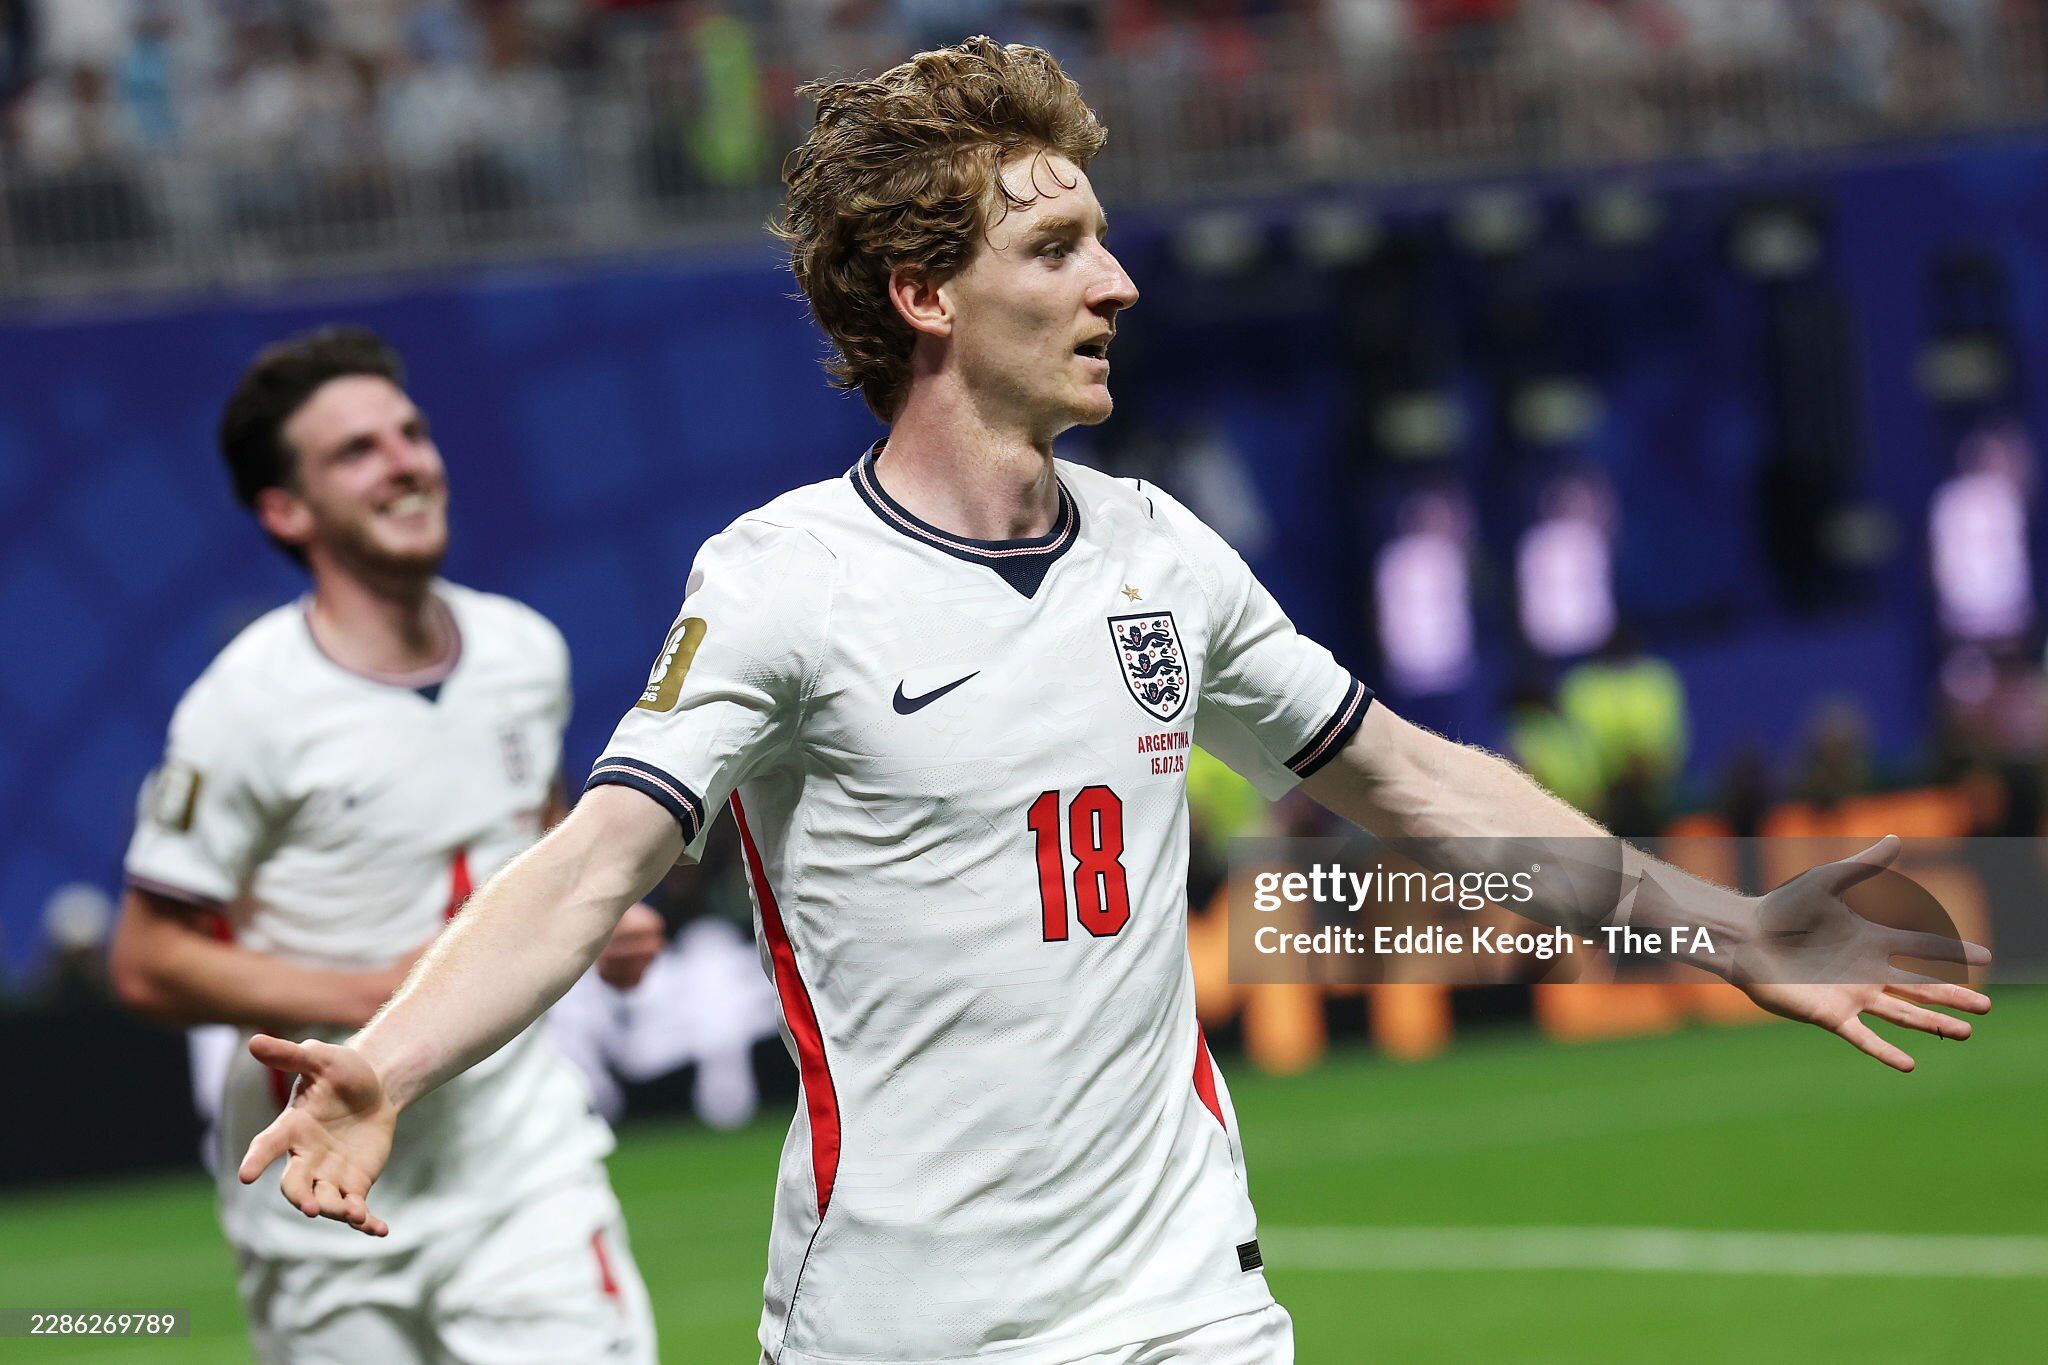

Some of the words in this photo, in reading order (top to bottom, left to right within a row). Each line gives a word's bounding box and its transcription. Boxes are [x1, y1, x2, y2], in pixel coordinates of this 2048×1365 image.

[1138, 731, 1190, 754] ARGENTINA
[1151, 755, 1184, 775] 15.07.26
[1027, 785, 1131, 942] 18
